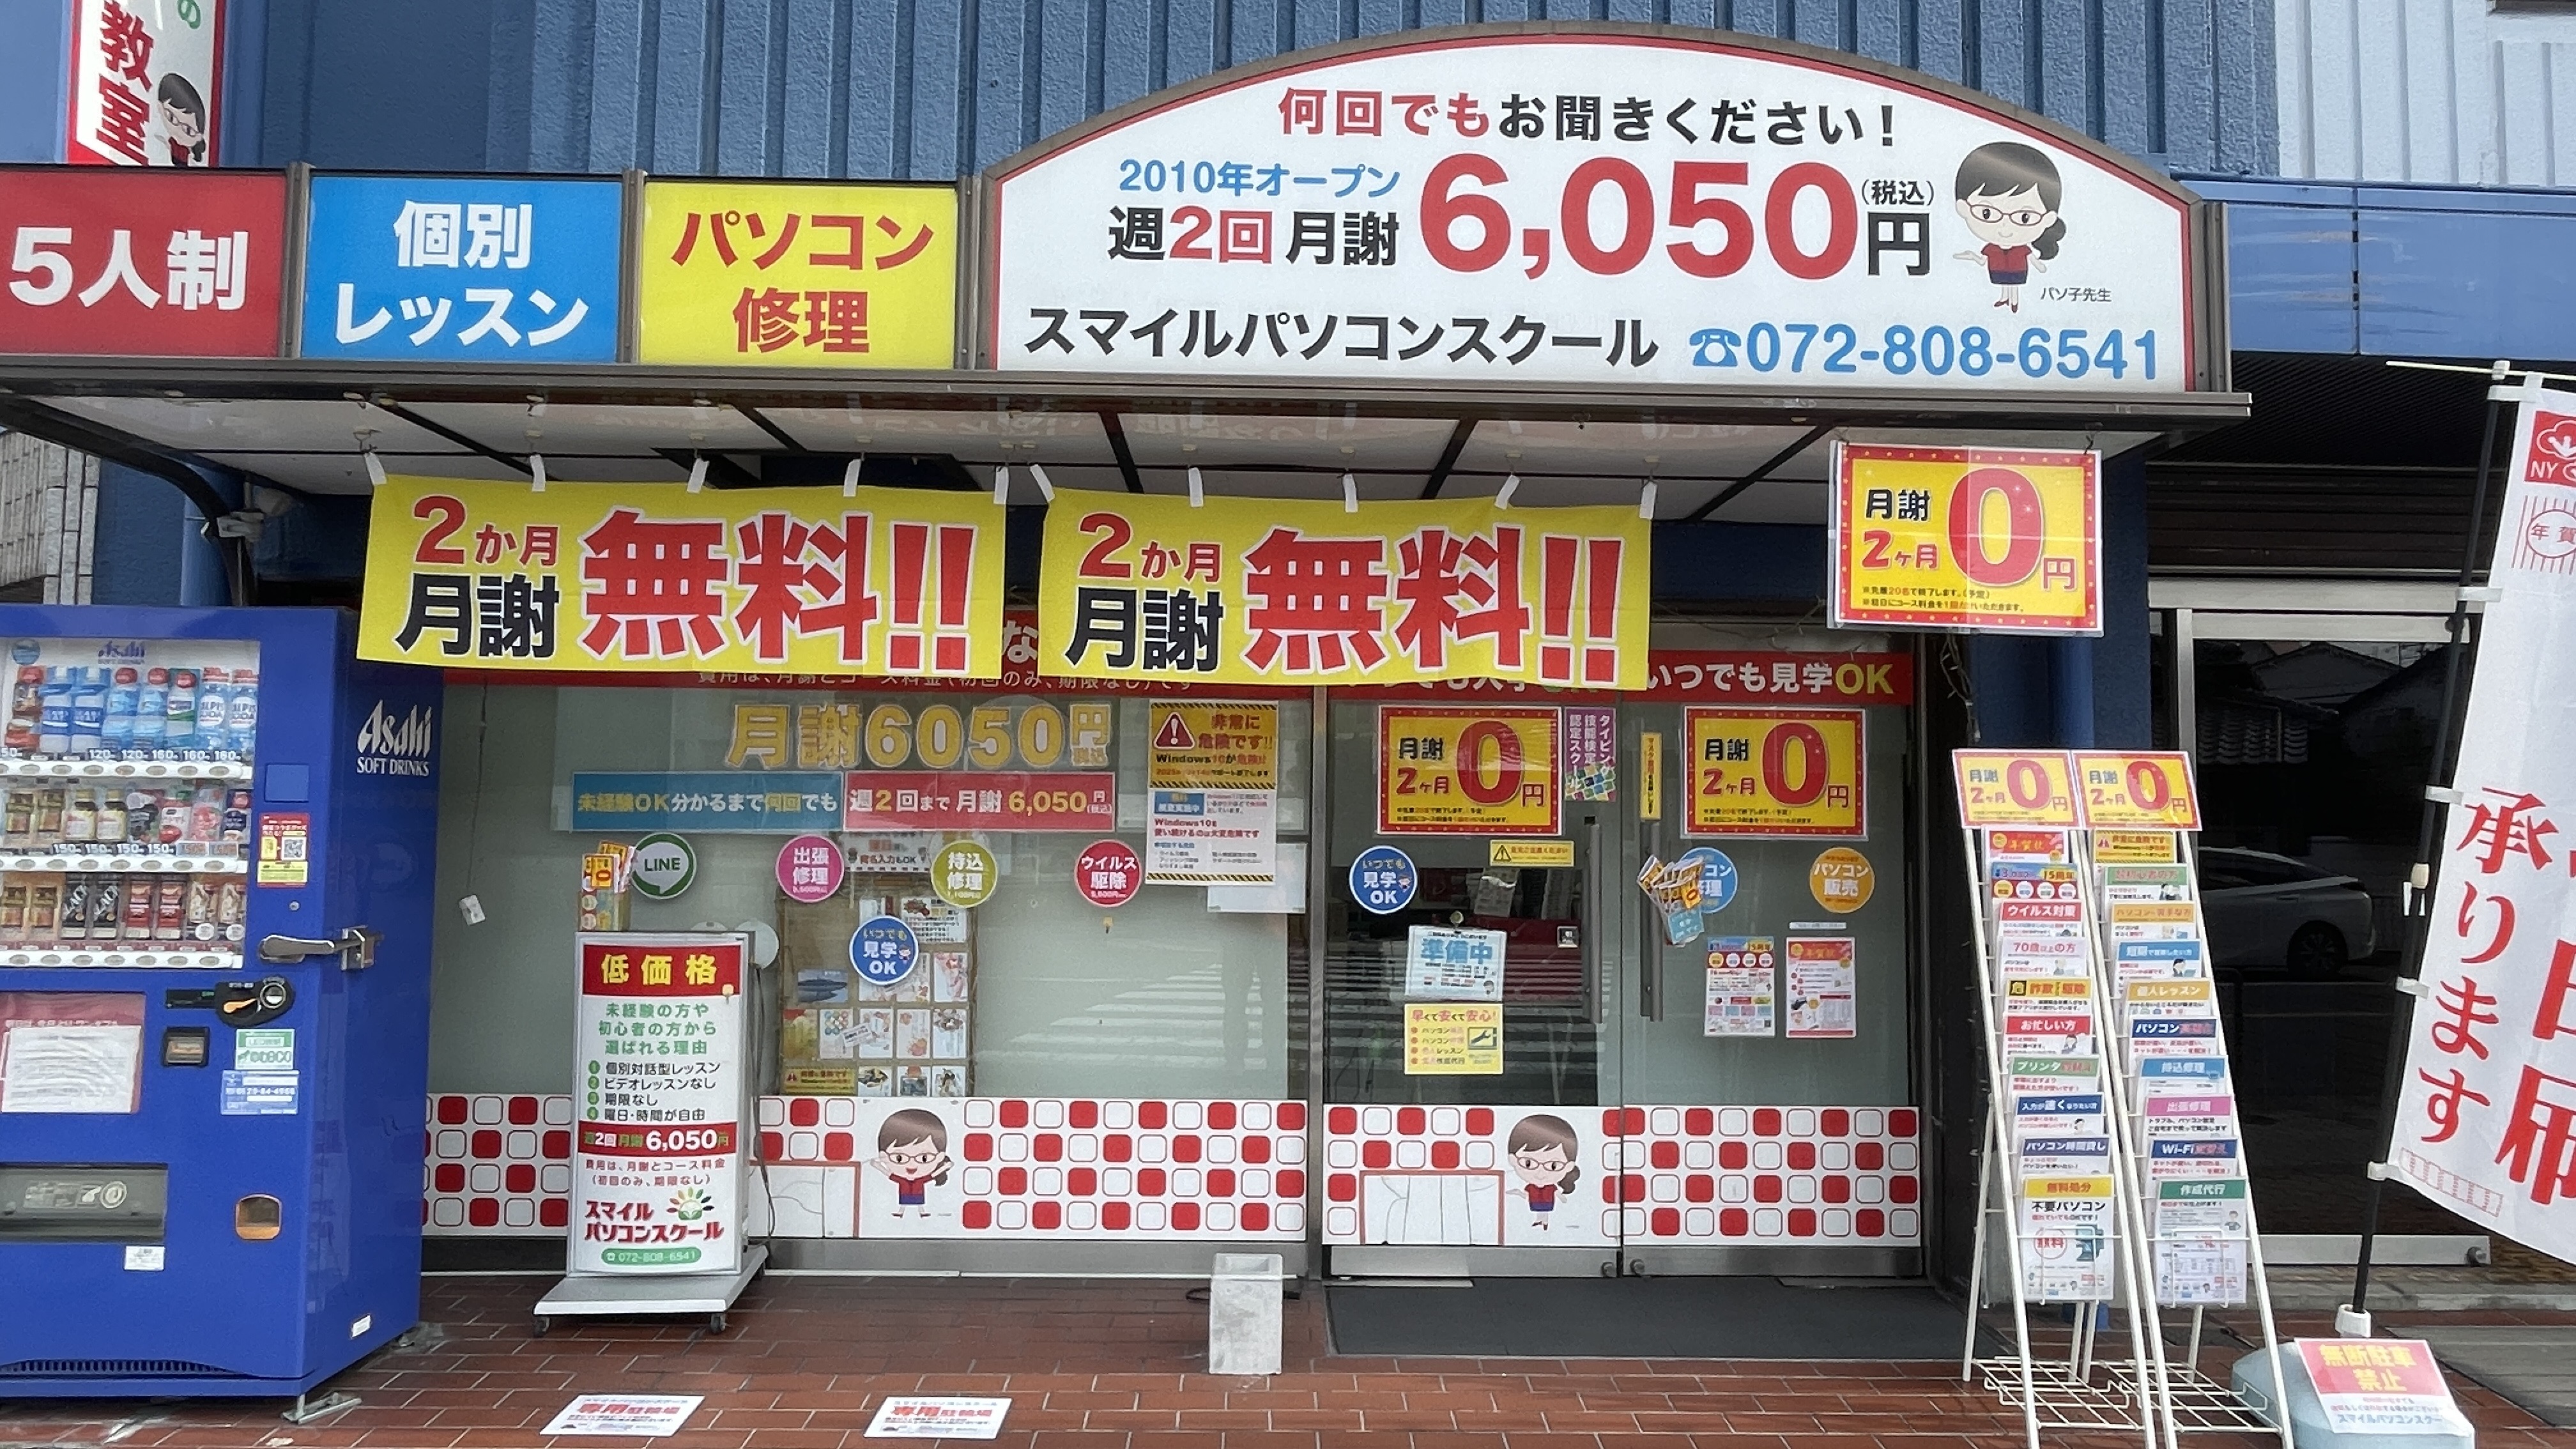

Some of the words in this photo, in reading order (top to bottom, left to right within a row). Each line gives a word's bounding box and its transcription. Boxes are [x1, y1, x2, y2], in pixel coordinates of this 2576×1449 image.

[1119, 158, 1401, 198] 2010年オープン
[1860, 180, 1936, 206] (税込)
[1108, 205, 1273, 264] 週2回
[1286, 211, 1400, 266] 月謝
[1420, 153, 1859, 280] 6,050
[1866, 212, 1931, 277] 円
[394, 200, 533, 268] 個別
[671, 210, 935, 270] パソコン
[9, 226, 249, 310] 5人制
[2040, 286, 2112, 302] パソ子先生
[336, 283, 589, 347] レッスン
[733, 288, 870, 354] 修理
[1024, 307, 1660, 369] スマイルパソコンスクール
[1746, 322, 2156, 381] 072-808-6541
[2530, 460, 2558, 479] NY
[1865, 488, 1931, 521] 月謝
[412, 495, 560, 567] 2か月
[1947, 467, 2044, 586] 0
[2043, 556, 2076, 591] 円
[1078, 512, 1223, 582] 2か月
[395, 572, 560, 658] 月謝
[1064, 587, 1224, 671] 月謝
[358, 698, 433, 758] Asahi
[1211, 714, 1261, 731] 非常に
[1397, 737, 1445, 762] 月謝
[1704, 738, 1749, 762] 月謝
[356, 756, 387, 774] SOFT
[388, 758, 430, 778] DRINKS
[1456, 719, 1523, 805] 0
[1522, 783, 1545, 808] 円
[1761, 722, 1828, 806] 0
[1827, 785, 1850, 808] 円
[1969, 769, 1999, 783] 月謝
[2007, 759, 2052, 810] 0
[2051, 796, 2069, 811] 円
[2089, 770, 2119, 785] 月謝
[2126, 760, 2171, 810] 0
[2171, 797, 2188, 813] 円
[577, 792, 838, 813] 未経験OK分かるまで何回でも
[850, 790, 949, 813] 週2回まで
[956, 790, 1003, 813] 月謝
[1008, 790, 1087, 816] 6,050
[1093, 790, 1106, 803] 円
[643, 857, 681, 872] LINE
[792, 847, 830, 866] 出張
[947, 852, 984, 871] 持込
[1080, 855, 1138, 871] ウイルス
[1361, 859, 1406, 870] いつでも
[792, 866, 829, 886] 修理
[1090, 871, 1128, 890] 駆除
[1363, 872, 1397, 889] 見学
[1705, 864, 1732, 878] コン
[1813, 863, 1869, 878] パソコン
[946, 872, 983, 891] 修理
[1823, 879, 1860, 897] 販売
[1370, 891, 1398, 904] OK
[863, 928, 907, 941] いつでも
[862, 942, 897, 958] 見学
[1420, 938, 1494, 965] 準備中
[601, 954, 717, 985] 低価格
[869, 961, 897, 975] OK
[2418, 786, 2559, 1143] 承ります
[606, 1002, 710, 1018] 未経験の方や
[597, 1021, 717, 1036] 初心者の方から
[2020, 1020, 2076, 1032] お忙しい方
[604, 1039, 708, 1055] 選ばれる理由
[606, 1061, 721, 1076] 個別対話型レッスン
[604, 1077, 717, 1091] ビデオレッスンなし
[604, 1093, 658, 1107] 期限なし
[645, 1129, 717, 1151] 6,050
[584, 1200, 654, 1221] スマイル
[2031, 1200, 2107, 1212] 不要パソコン
[584, 1222, 724, 1243] パソコンスクール
[2319, 1344, 2417, 1367] 無断駐車
[2352, 1368, 2407, 1392] 禁止
